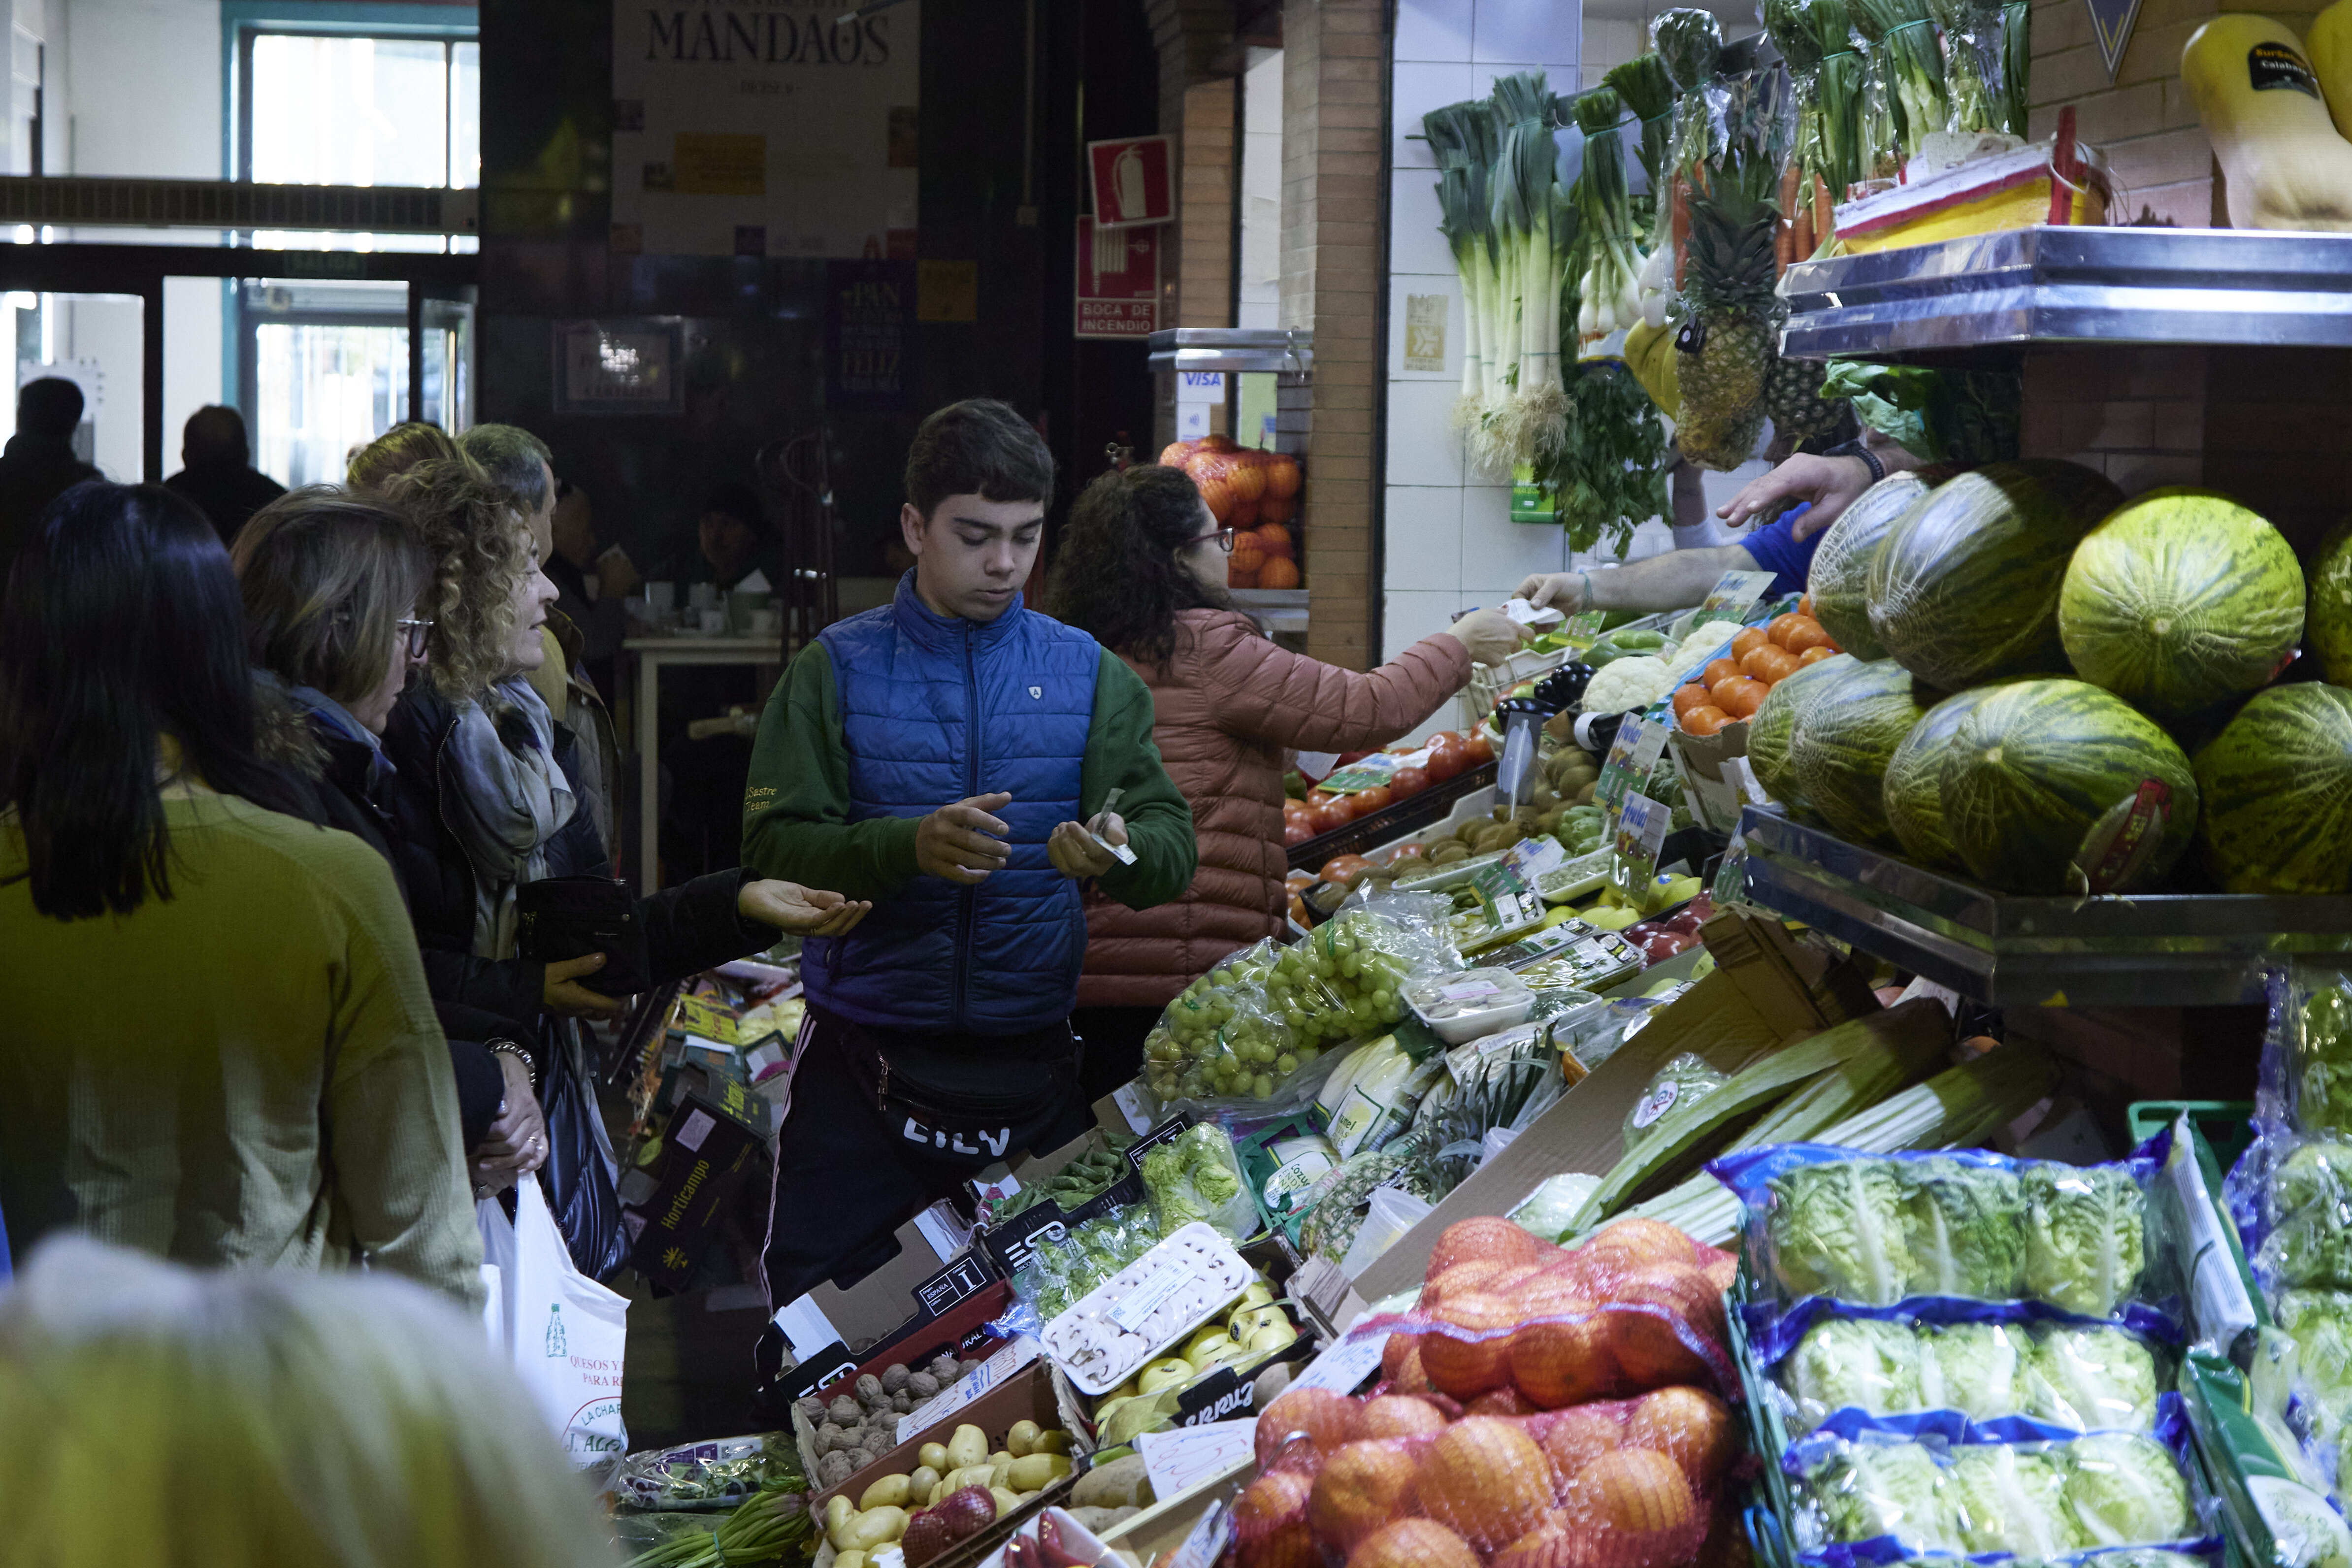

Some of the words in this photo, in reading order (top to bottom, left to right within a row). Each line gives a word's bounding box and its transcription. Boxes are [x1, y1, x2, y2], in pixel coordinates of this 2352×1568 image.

[646, 8, 890, 67] MANDAOS
[1082, 304, 1122, 316] BOCA
[1131, 304, 1150, 316] DE
[1082, 319, 1150, 332] INCENDIO
[1185, 372, 1221, 387] VISA
[749, 786, 777, 798] Sastre
[745, 800, 770, 812] Team
[660, 1159, 710, 1230] Horticampo
[957, 1269, 977, 1291] I
[926, 1282, 949, 1300] ESPAÑA
[570, 1355, 609, 1371] QUESOS
[611, 1360, 620, 1371] Y
[583, 1372, 609, 1387] PARA
[581, 1411, 595, 1426] LA
